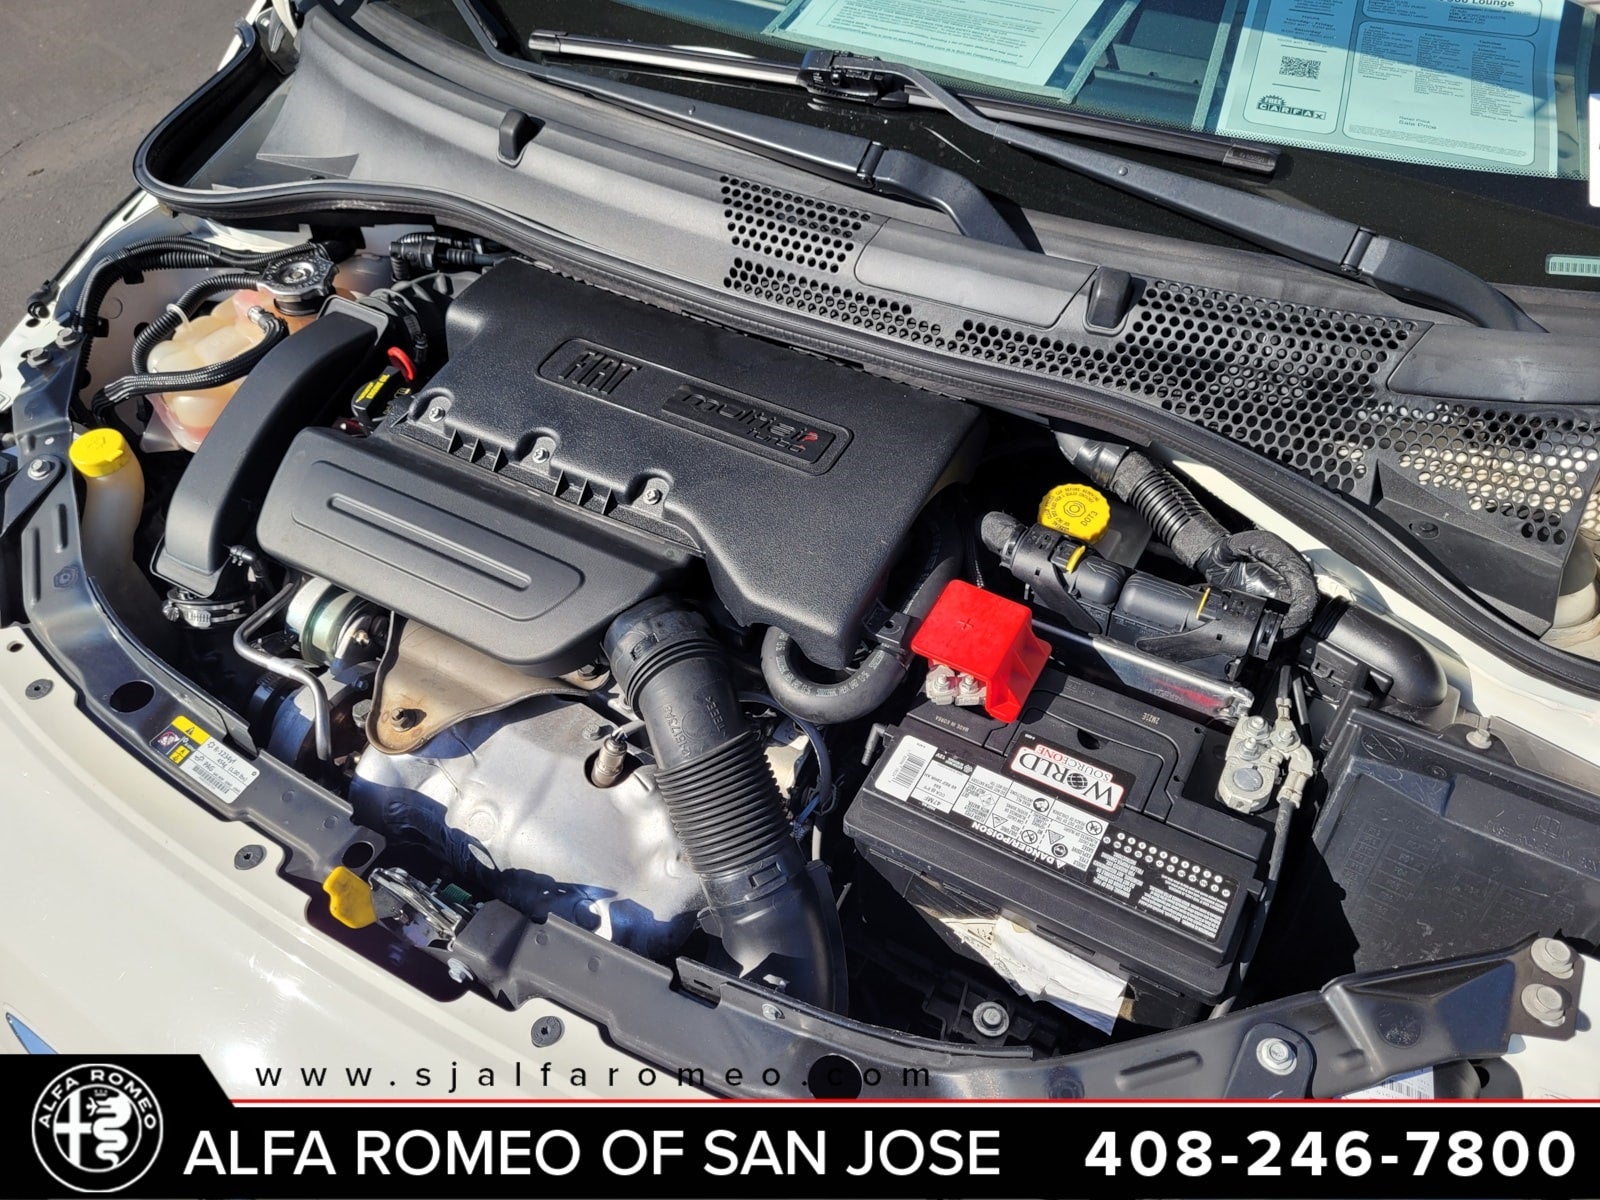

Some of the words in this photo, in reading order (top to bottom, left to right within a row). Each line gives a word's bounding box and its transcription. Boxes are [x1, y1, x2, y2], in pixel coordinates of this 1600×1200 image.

[1258, 103, 1325, 120] CARFAX
[558, 351, 642, 395] FIAT
[971, 820, 1055, 864] DANGER/POISON
